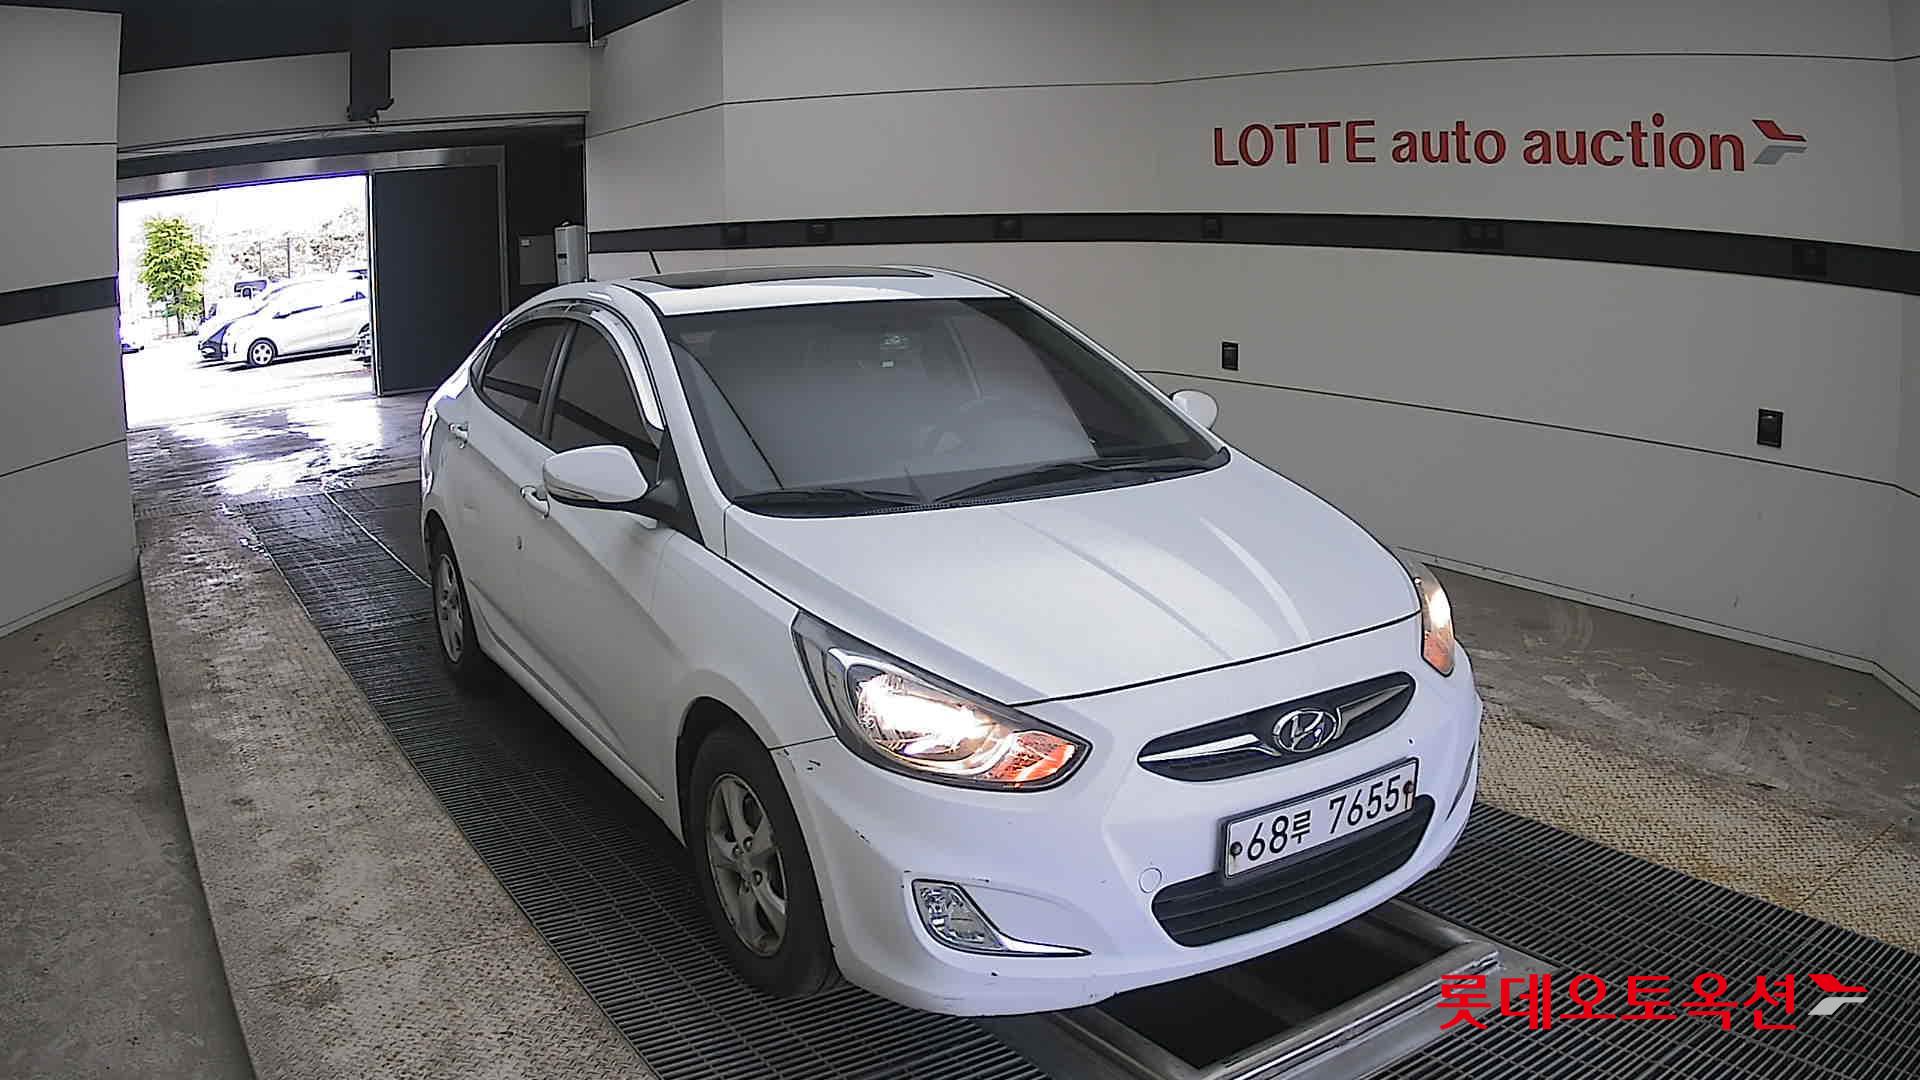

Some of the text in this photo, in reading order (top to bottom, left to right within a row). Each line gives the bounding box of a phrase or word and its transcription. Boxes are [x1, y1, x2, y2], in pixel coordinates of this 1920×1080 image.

[1214, 113, 1745, 171] LOTTE auto auction
[1247, 775, 1401, 861] 68루 7655
